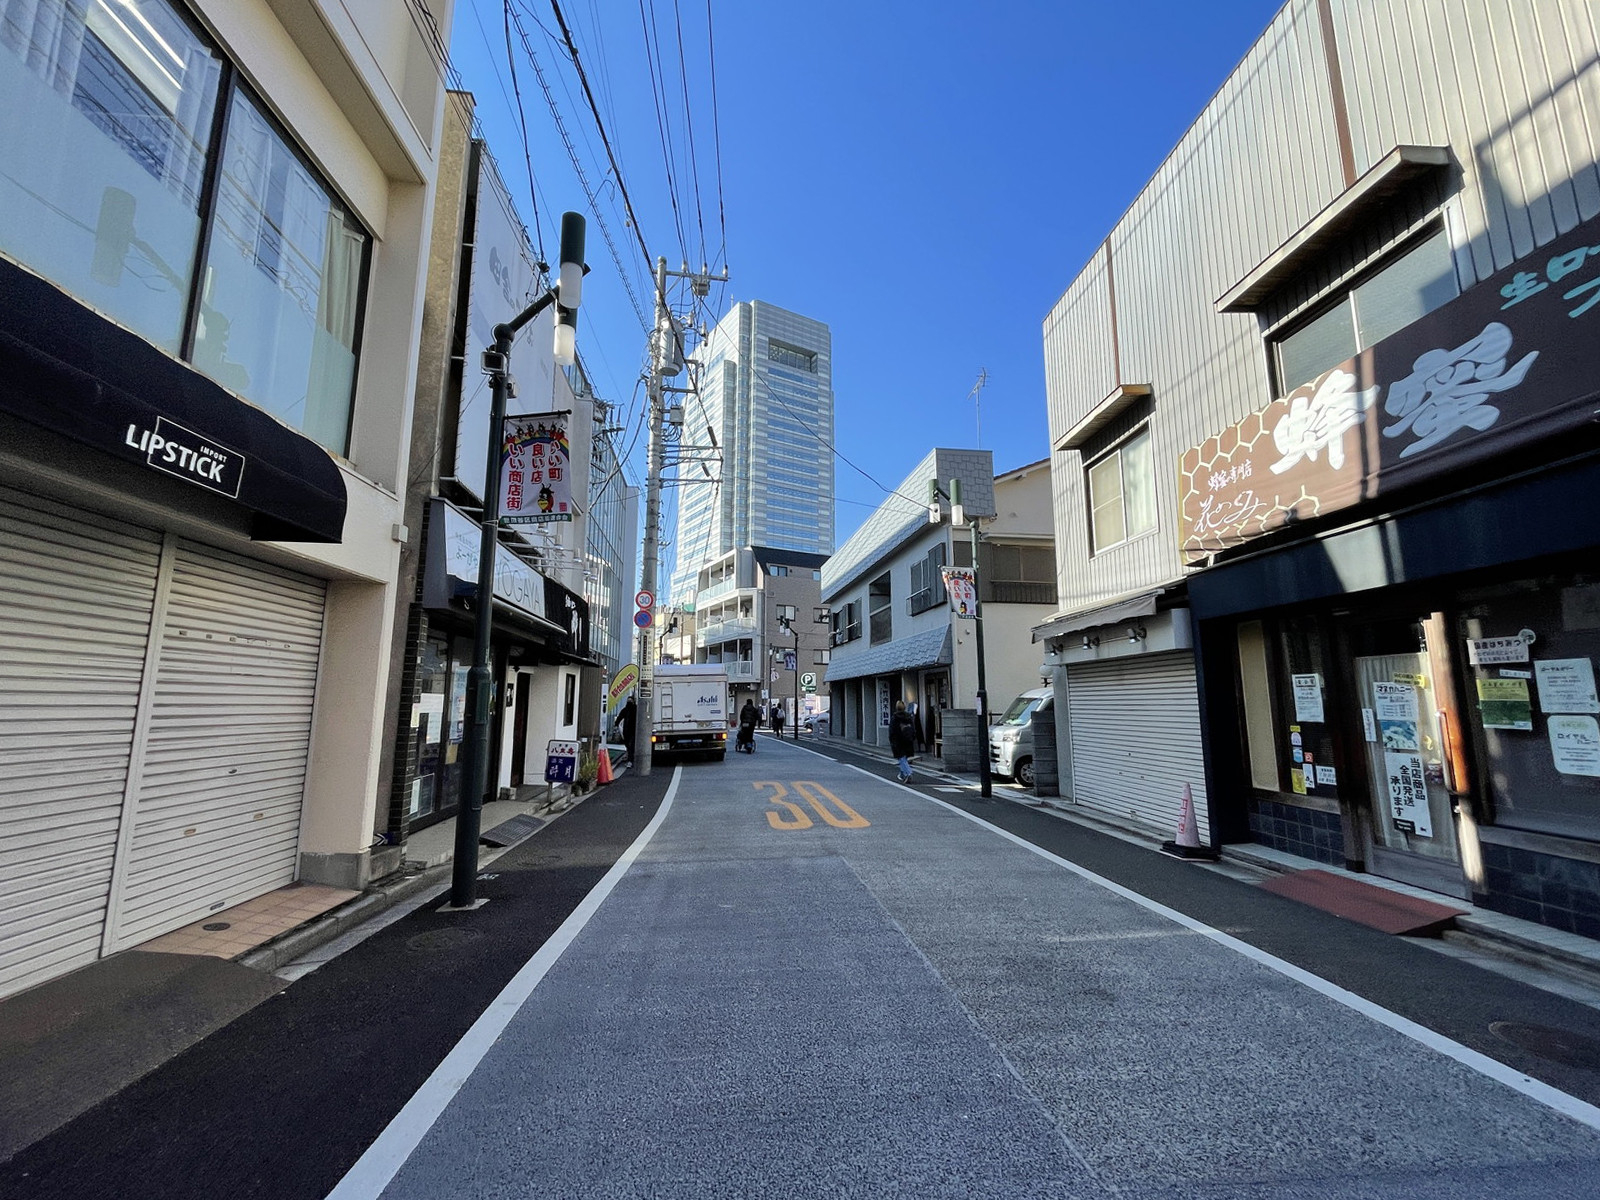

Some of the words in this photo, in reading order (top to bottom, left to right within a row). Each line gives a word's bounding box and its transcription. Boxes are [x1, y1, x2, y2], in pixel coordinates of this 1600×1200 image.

[1269, 322, 1540, 475] 蜂蜜
[125, 424, 225, 483] LIPSTICK
[200, 446, 227, 463] IMPORT
[531, 443, 545, 484] 良い店
[507, 442, 525, 511] いい商店街
[639, 595, 650, 604] 30
[697, 695, 718, 704] Asahi
[1390, 775, 1404, 816] 承ります
[1400, 765, 1415, 807] 全国発送
[1410, 757, 1426, 800] 当店商品
[752, 781, 871, 830] 30
